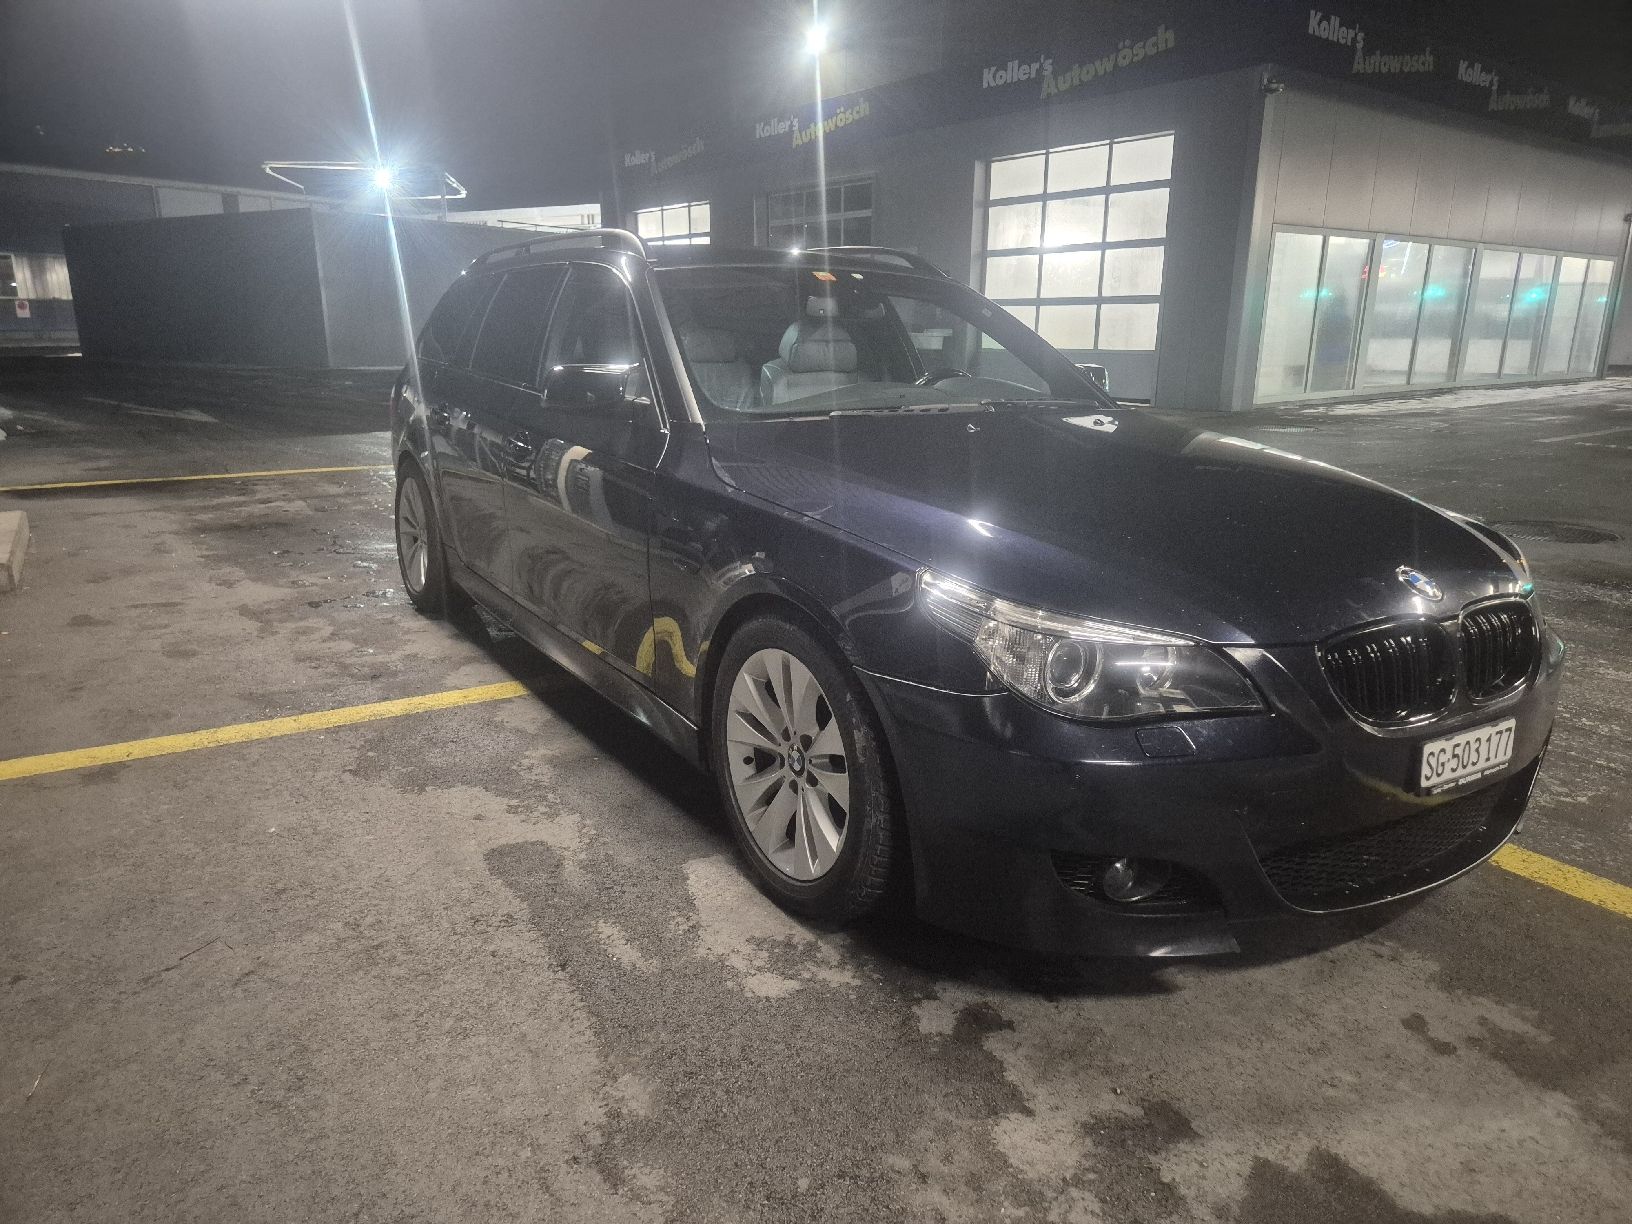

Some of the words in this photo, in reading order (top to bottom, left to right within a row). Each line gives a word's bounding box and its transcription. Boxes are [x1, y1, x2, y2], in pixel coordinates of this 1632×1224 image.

[1308, 10, 1364, 48] Koller's
[982, 55, 1053, 88] Koller's
[1040, 24, 1175, 99] Autowösch
[756, 114, 799, 139] Koller's
